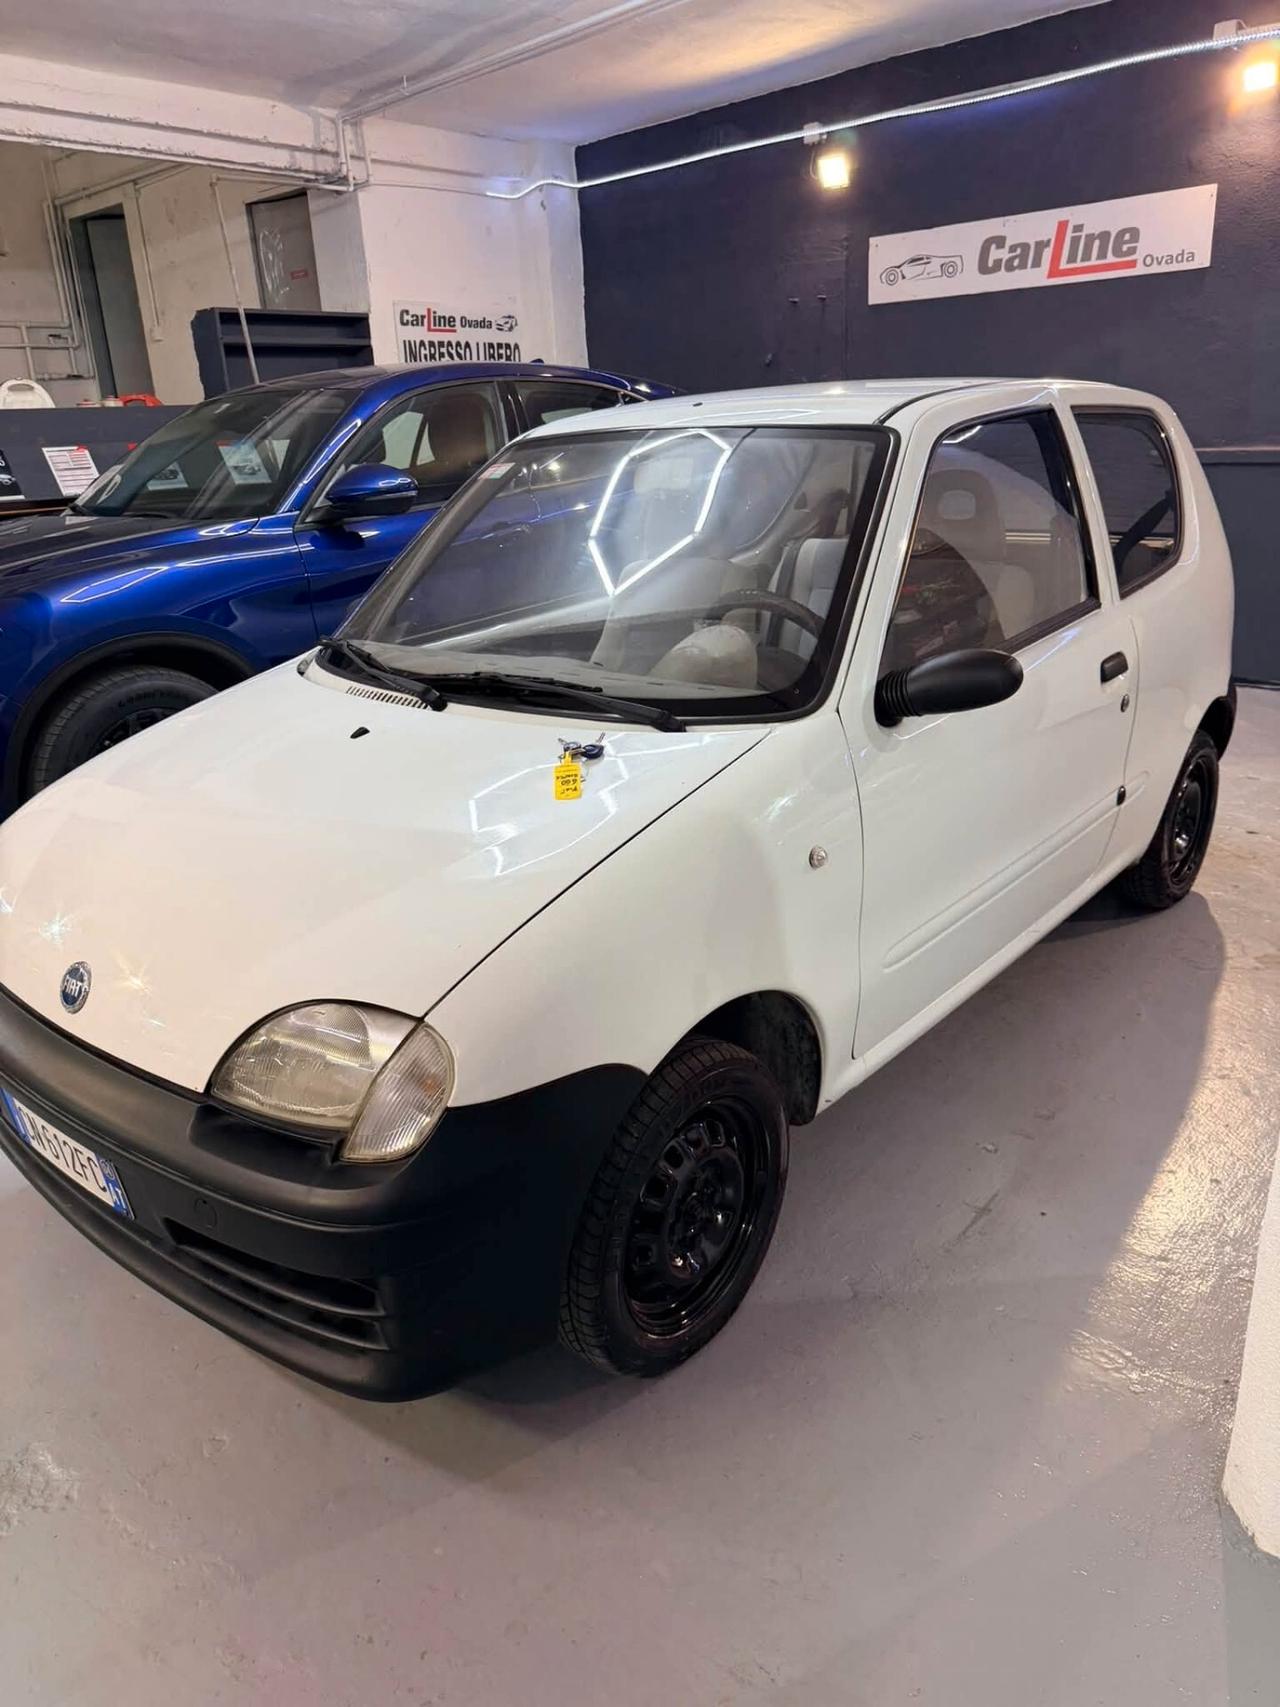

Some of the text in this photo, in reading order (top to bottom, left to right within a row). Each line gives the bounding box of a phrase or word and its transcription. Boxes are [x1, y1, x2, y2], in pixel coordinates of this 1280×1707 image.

[978, 219, 1196, 279] CarLine Ovada
[400, 308, 493, 333] CarLine Ovada
[403, 340, 473, 363] INGRESSO
[63, 974, 83, 998] FIAT
